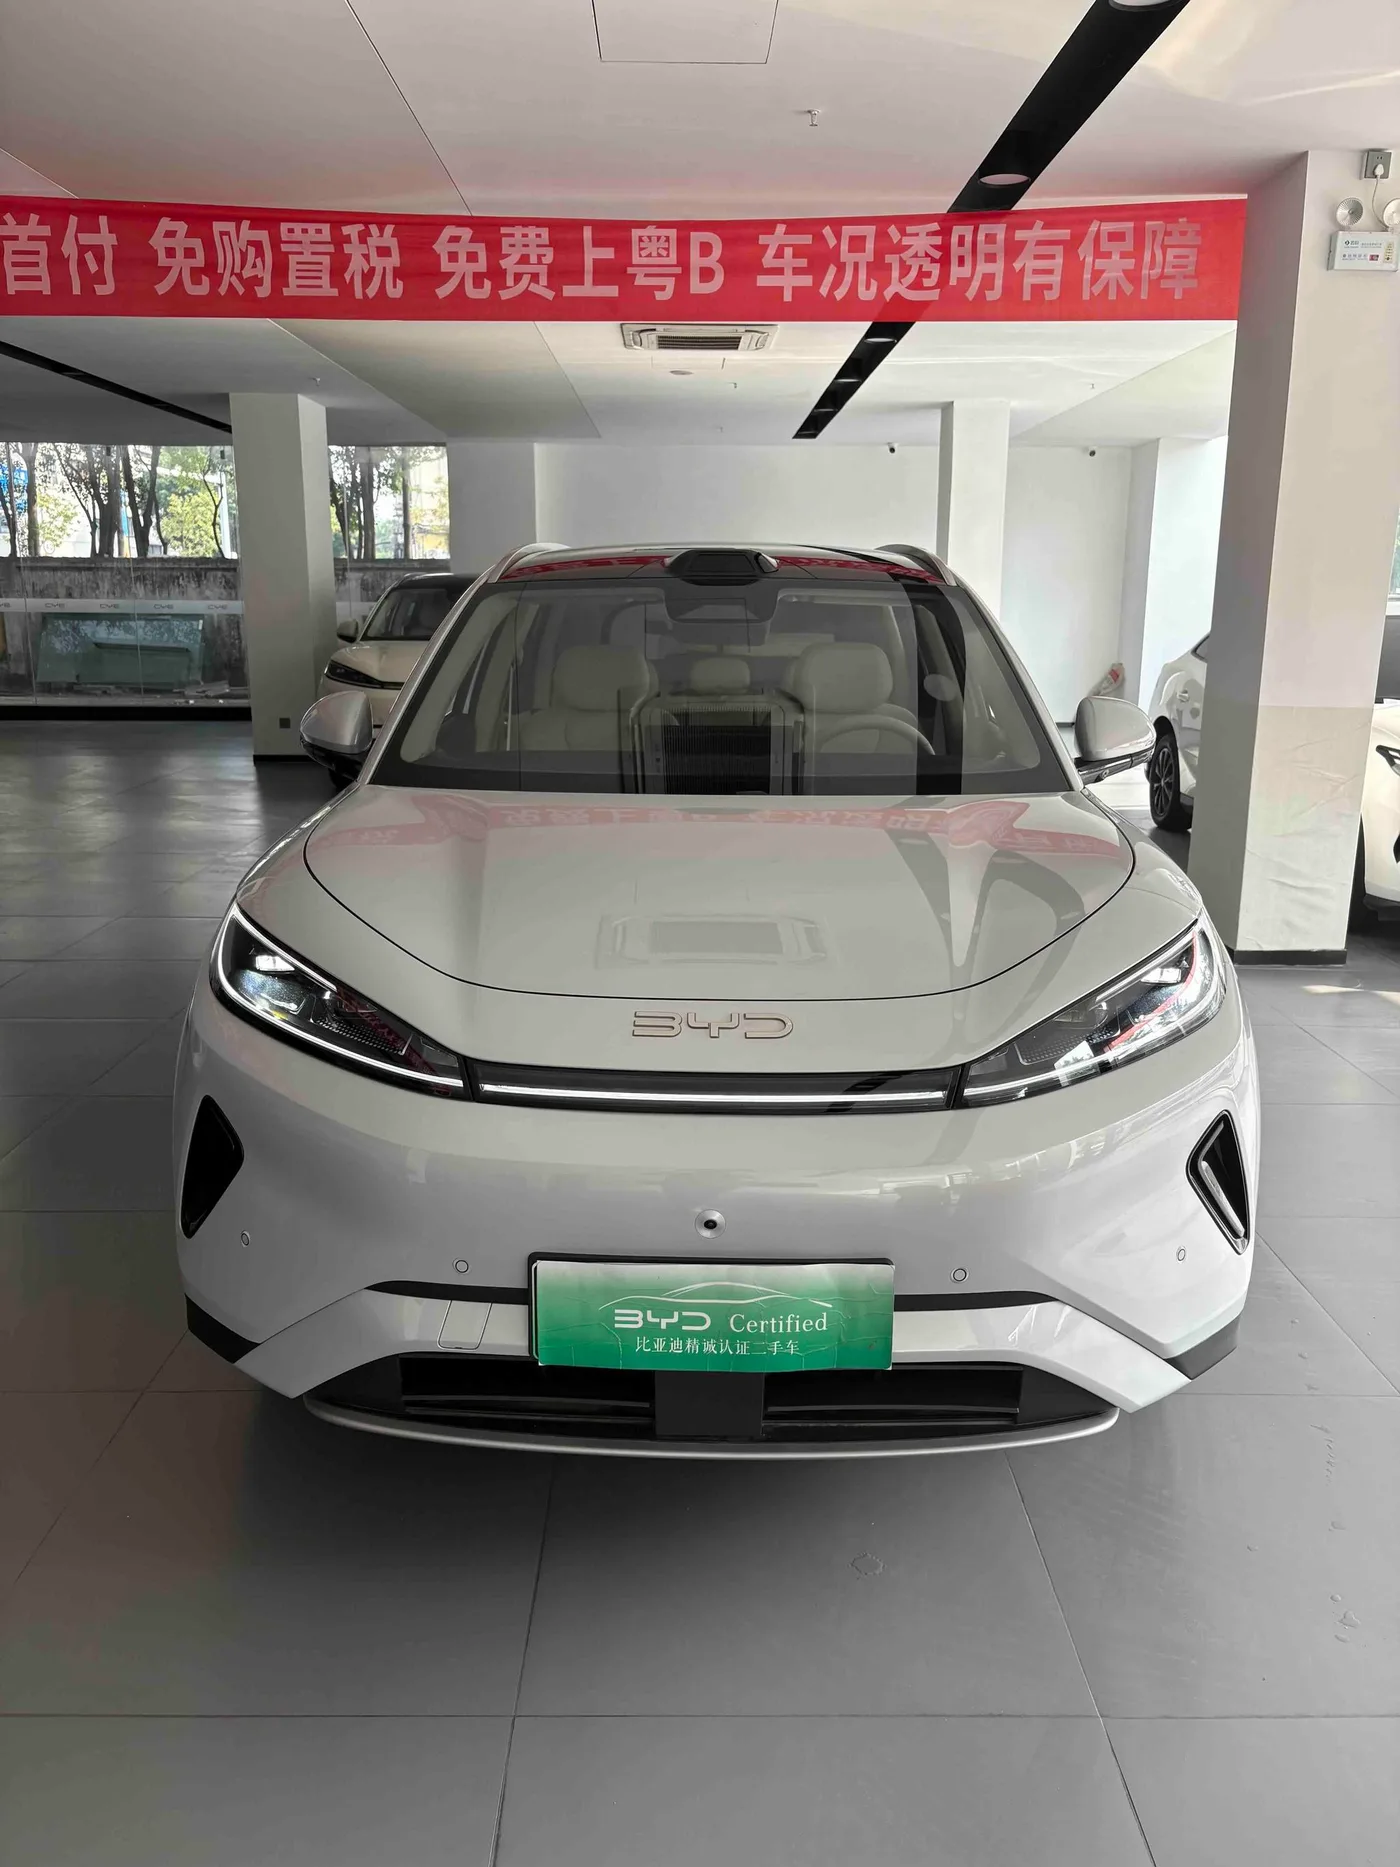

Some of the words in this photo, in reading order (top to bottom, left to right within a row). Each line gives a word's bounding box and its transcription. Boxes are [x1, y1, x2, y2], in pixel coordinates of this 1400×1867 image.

[1, 212, 118, 296] 首付
[148, 216, 404, 299] 免购置税
[433, 224, 724, 301] 免费上粤B
[756, 218, 1200, 302] 车况透明有保障
[632, 1011, 794, 1039] BYD
[614, 1309, 711, 1331] BYD
[729, 1313, 828, 1333] Certified
[635, 1336, 800, 1356] 比亚迪精诚认证二手车
